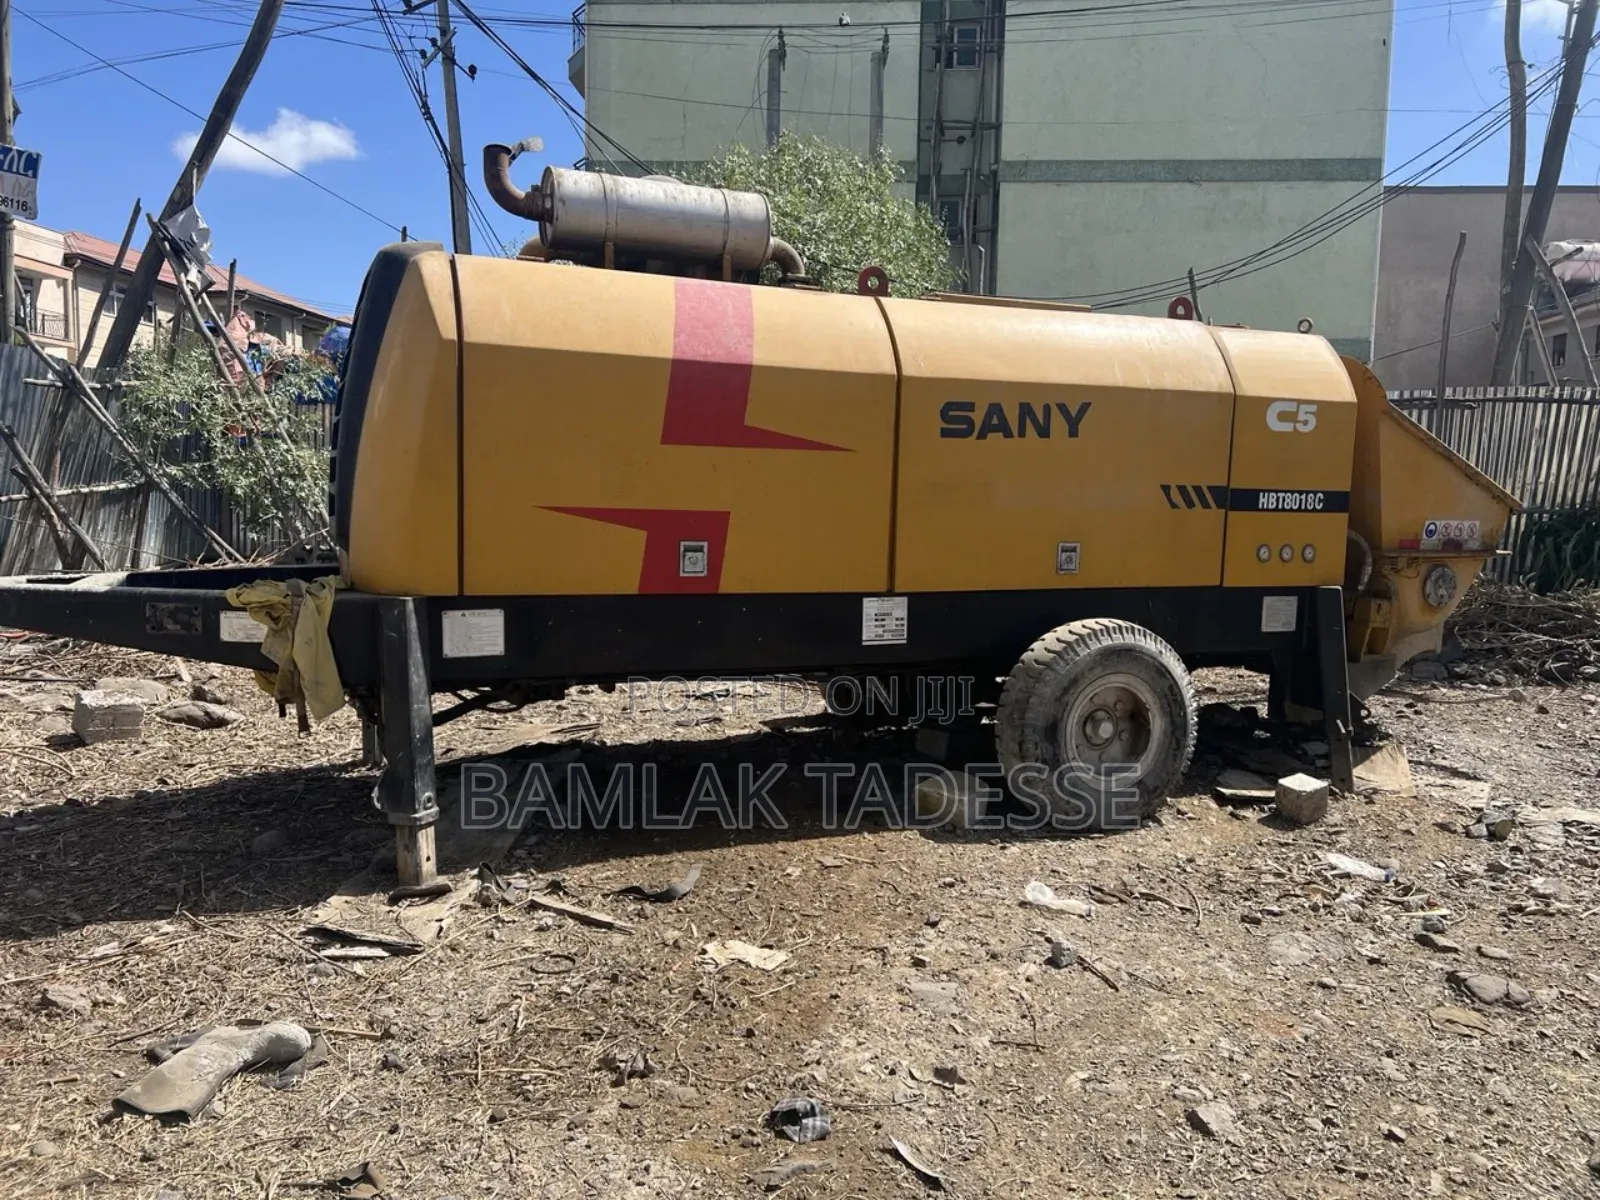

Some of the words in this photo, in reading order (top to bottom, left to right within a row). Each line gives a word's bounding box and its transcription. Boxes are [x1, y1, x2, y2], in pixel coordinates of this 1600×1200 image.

[939, 401, 1092, 440] SANY
[1265, 400, 1318, 433] C5
[1258, 491, 1324, 510] HBT8018C
